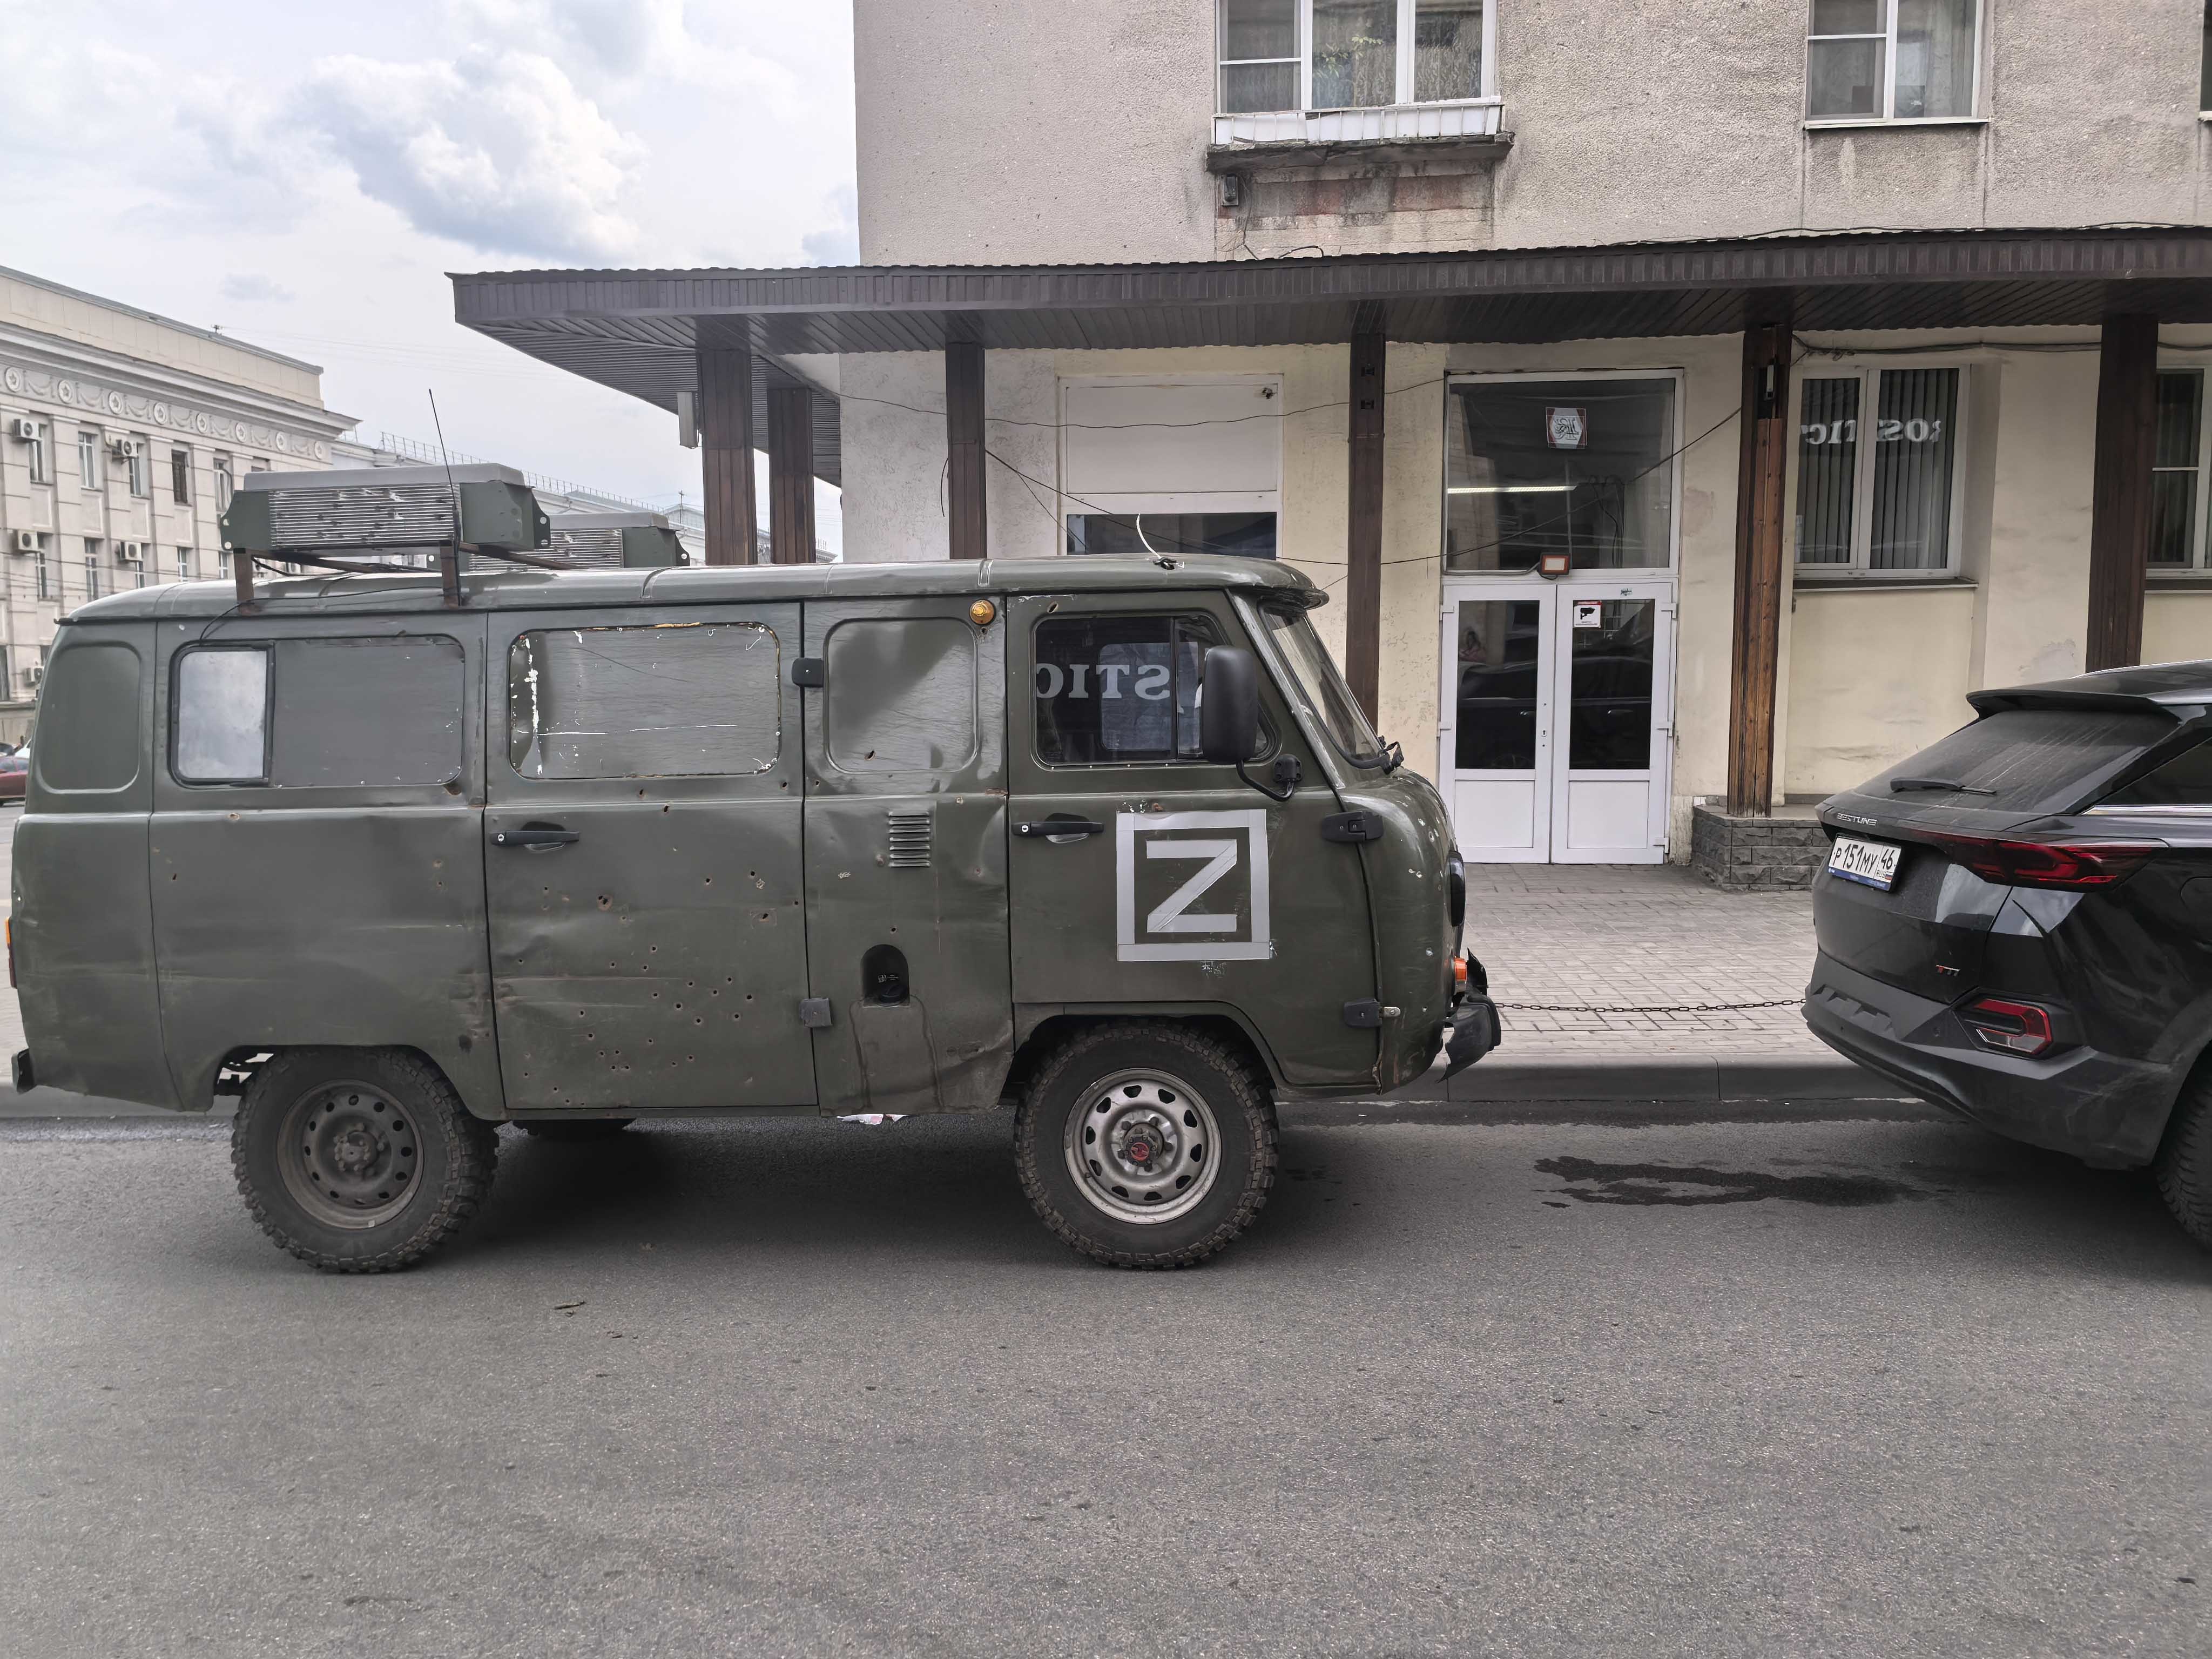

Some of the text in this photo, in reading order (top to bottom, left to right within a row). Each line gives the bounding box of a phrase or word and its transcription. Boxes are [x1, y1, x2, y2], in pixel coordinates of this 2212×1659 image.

[1837, 813, 1877, 826] BESTUNE
[1881, 848, 1895, 870] 46
[1876, 869, 1886, 878] RUS
[1146, 839, 1237, 933] Z
